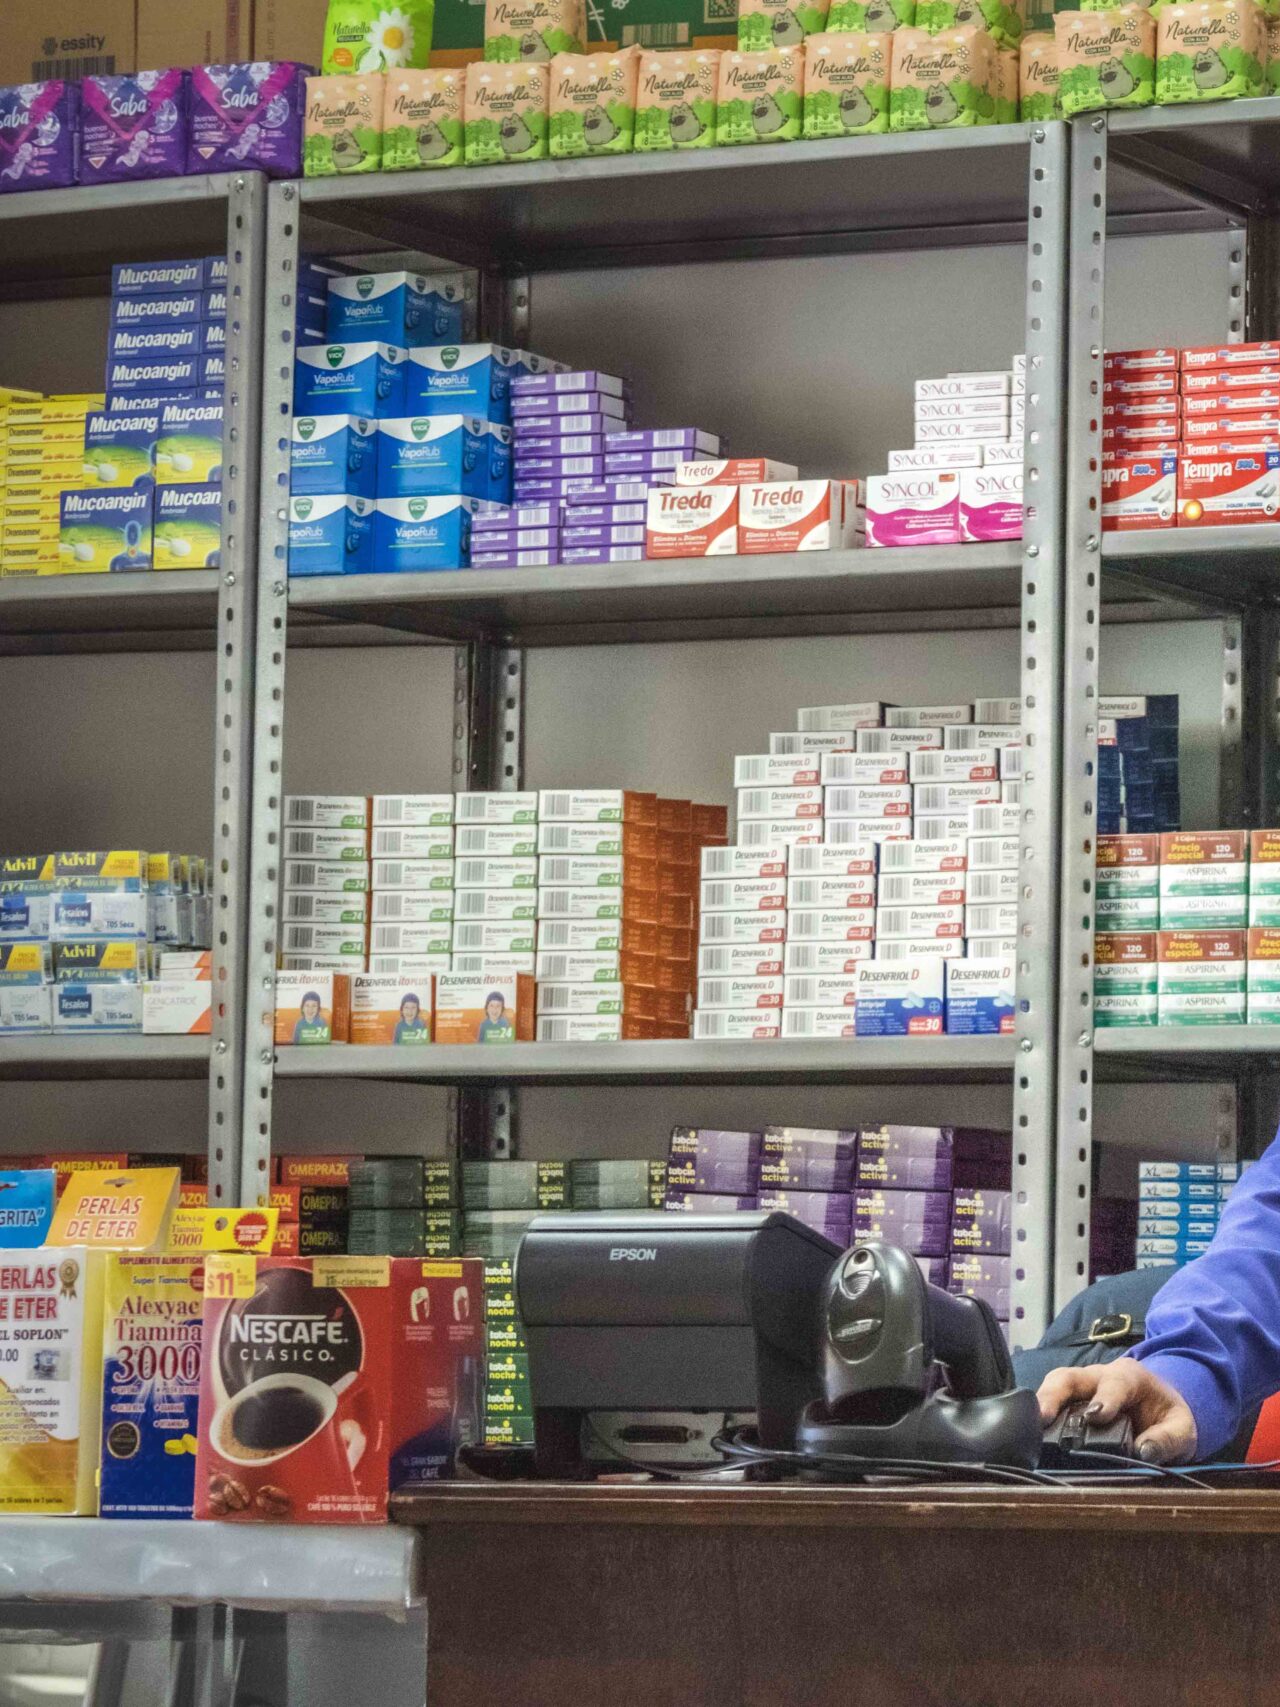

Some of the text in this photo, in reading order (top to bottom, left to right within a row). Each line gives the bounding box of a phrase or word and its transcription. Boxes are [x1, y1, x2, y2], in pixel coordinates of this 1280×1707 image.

[493, 3, 550, 22] Naturella
[333, 22, 372, 36] Naturella
[1166, 21, 1228, 38] Naturella
[61, 34, 105, 51] essity
[1068, 28, 1128, 51] Naturella
[812, 59, 872, 78] Naturella
[558, 78, 612, 96] Naturella
[221, 86, 259, 108] Saba
[110, 94, 147, 118] Saba
[309, 102, 361, 122] Naturella
[118, 265, 199, 285] Mucoangin
[116, 298, 195, 318] Mucoangin
[344, 305, 383, 317] VapoRub
[114, 330, 195, 349] Mucoangin
[328, 351, 343, 360] VICK
[442, 353, 457, 361] VICK
[1185, 351, 1217, 364] Tempra
[112, 363, 192, 382] Mucoangin
[314, 373, 355, 385] VapoRub
[428, 374, 469, 386] VapoRub
[920, 382, 964, 396] SYNCOL
[919, 403, 964, 417] SYNCOL
[89, 416, 158, 433] Mucoang
[919, 423, 964, 437] SYNCOL
[398, 446, 440, 459] VapoRub
[893, 453, 938, 467] SYNCOL
[683, 465, 714, 476] Treda
[1181, 460, 1233, 482] Tempra
[752, 486, 803, 506] Treda
[881, 481, 939, 499] SYNCOL
[64, 493, 147, 512] Mucoangin
[660, 491, 713, 511] Treda
[1167, 851, 1204, 860] especial
[1172, 843, 1231, 853] Precio 120
[2, 857, 37, 873] Advil
[58, 852, 96, 867] Advil
[60, 945, 96, 958] Advil
[860, 969, 919, 982] DESENFRIOL D
[951, 967, 1010, 980] DESENFRIOL D
[500, 1026, 512, 1038] 24
[926, 1019, 940, 1031] 30
[765, 1131, 793, 1144] tabcin
[861, 1130, 890, 1141] tabcin
[861, 1140, 890, 1149] active
[77, 1197, 142, 1214] PERLAS
[66, 1220, 138, 1238] DE ETER
[610, 1248, 657, 1261] EPSON
[216, 1273, 233, 1296] 11
[14, 1297, 57, 1320] ETER
[120, 1296, 199, 1320] Alexyac
[114, 1318, 202, 1342] Tiamina
[490, 1329, 516, 1340] tabcin
[490, 1339, 517, 1348] noche
[114, 1345, 200, 1381] 3000
